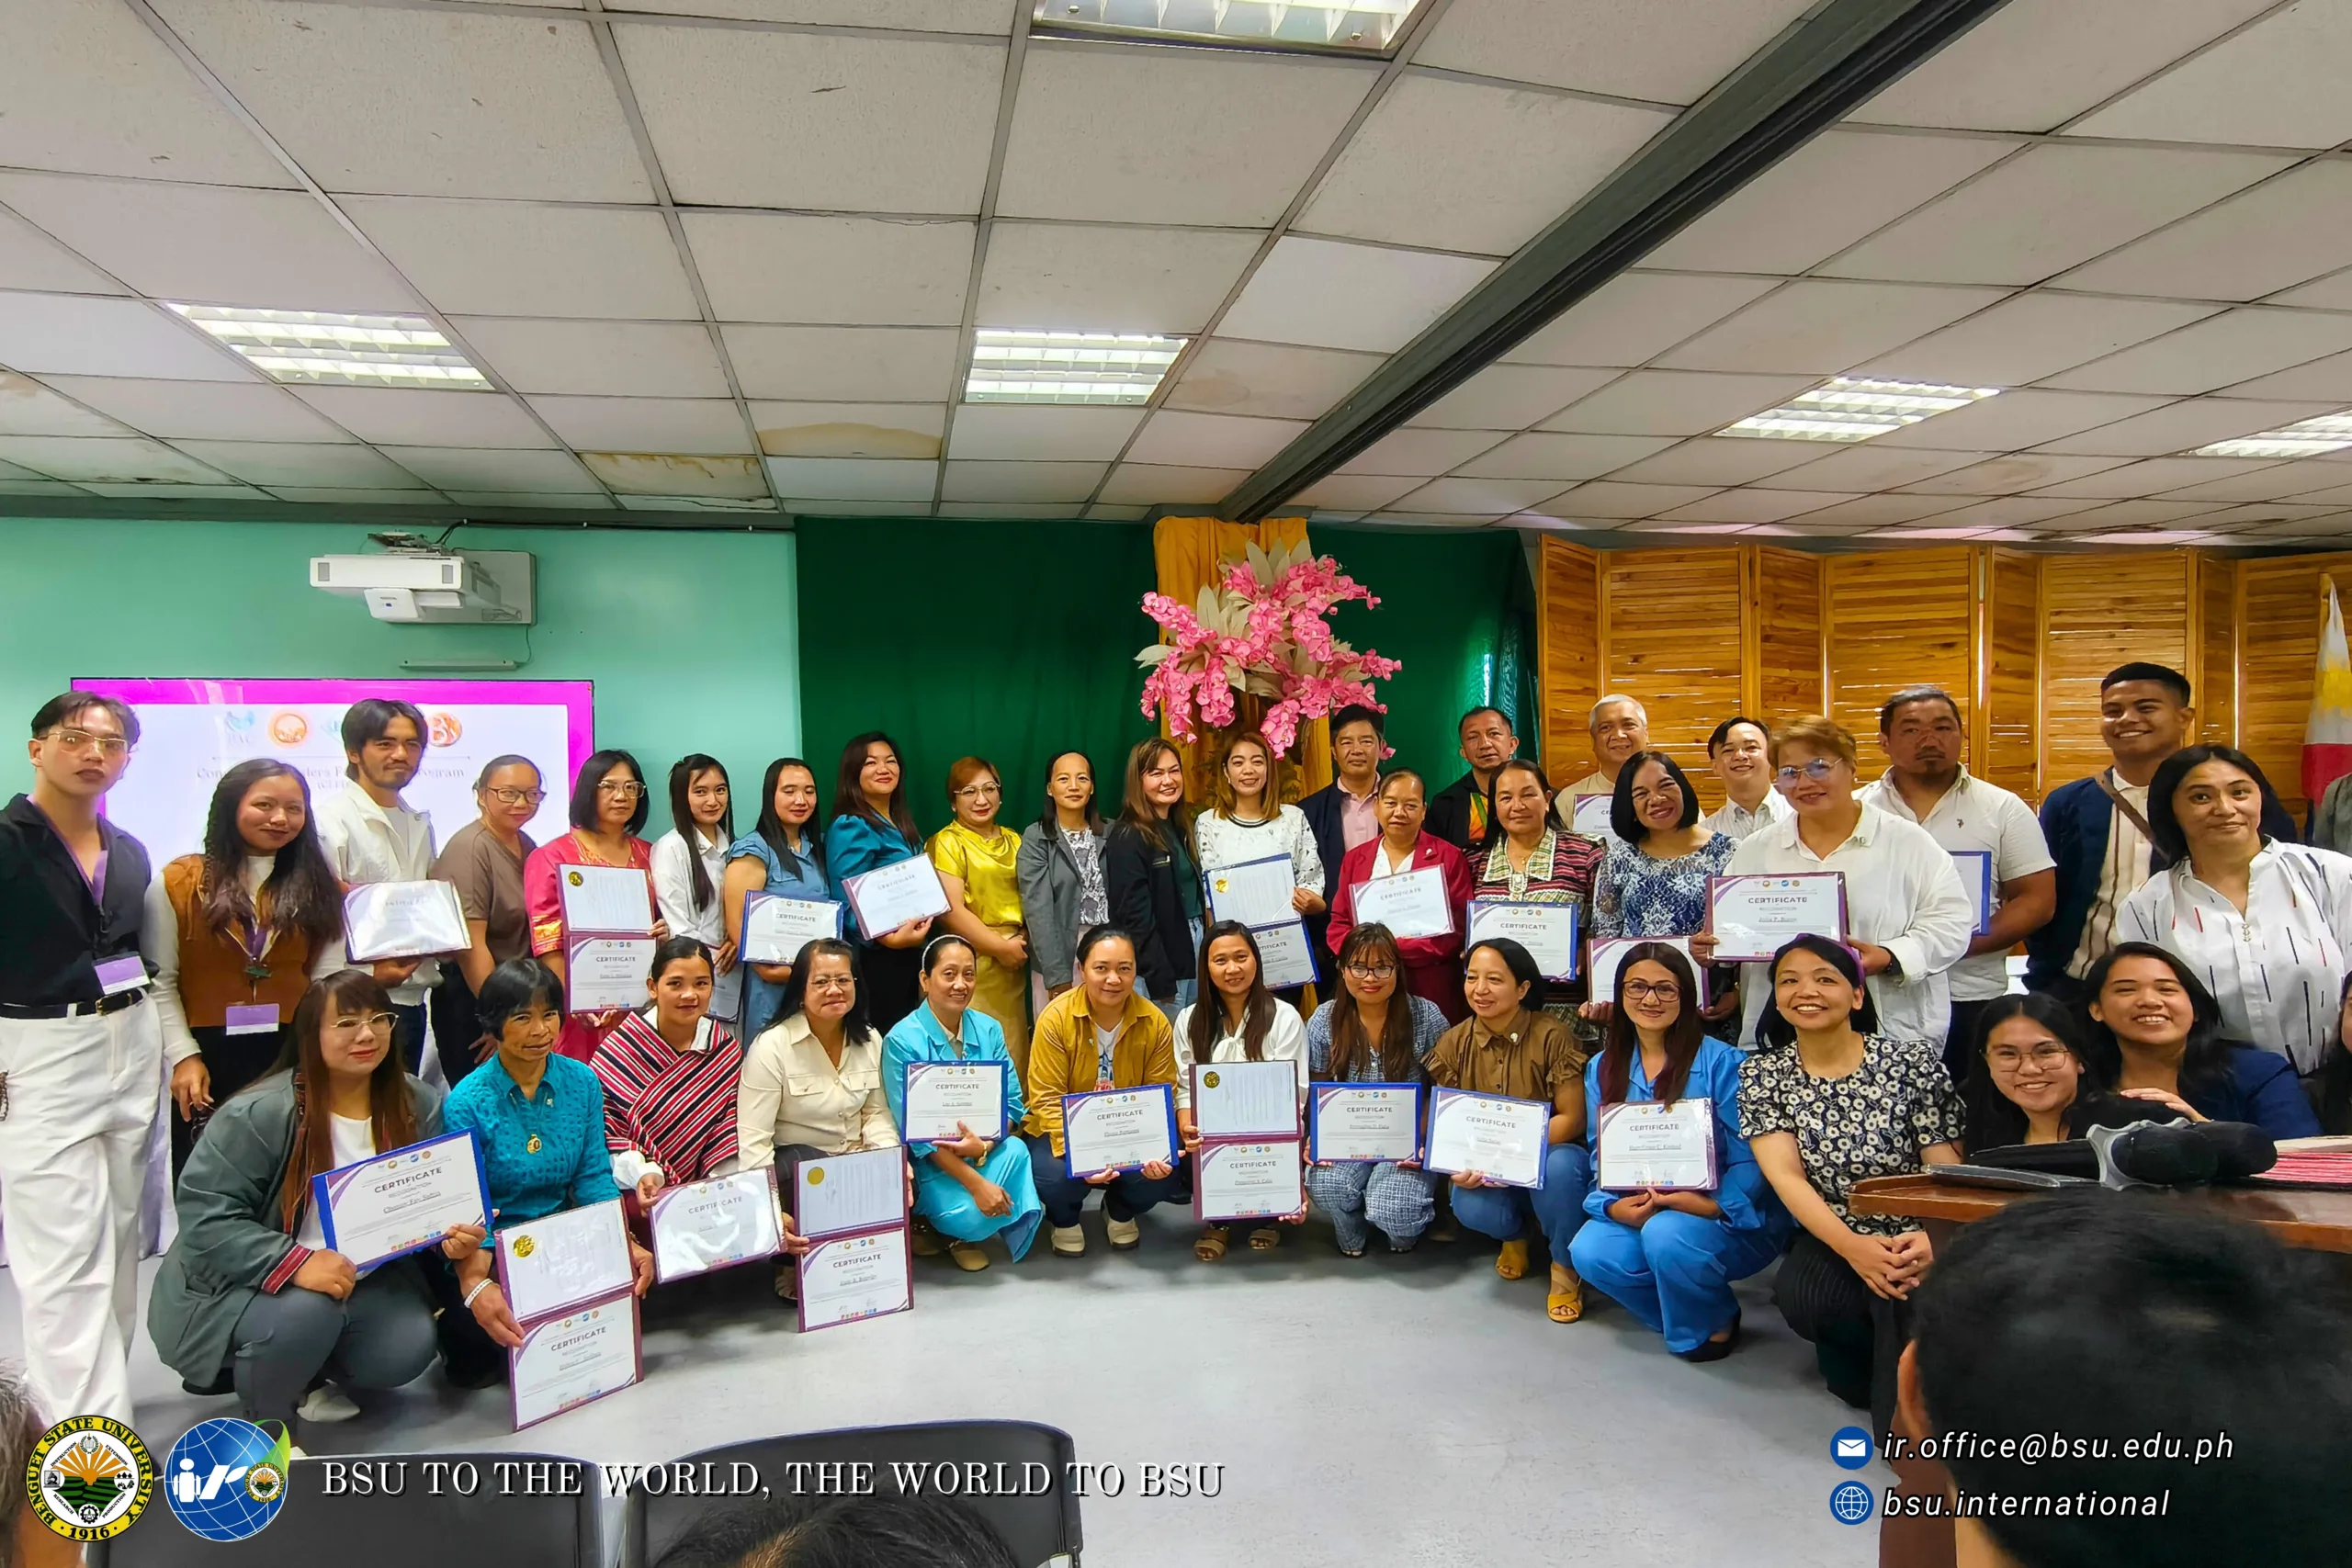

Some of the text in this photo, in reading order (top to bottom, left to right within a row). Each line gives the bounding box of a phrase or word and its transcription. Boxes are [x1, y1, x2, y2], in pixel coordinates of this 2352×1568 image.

[1097, 1109, 1143, 1121] CERTIFICATE
[1465, 1115, 1516, 1129] CERTIFICATE
[1629, 1123, 1679, 1132] CERTIFICATE
[1229, 1160, 1276, 1169] CERTIFICATE
[374, 1166, 442, 1193] CERTIFICATE
[688, 1196, 742, 1213] CERTIFCATE
[832, 1253, 882, 1268] CERTIFICATE
[551, 1325, 606, 1352] CERTIFICATE
